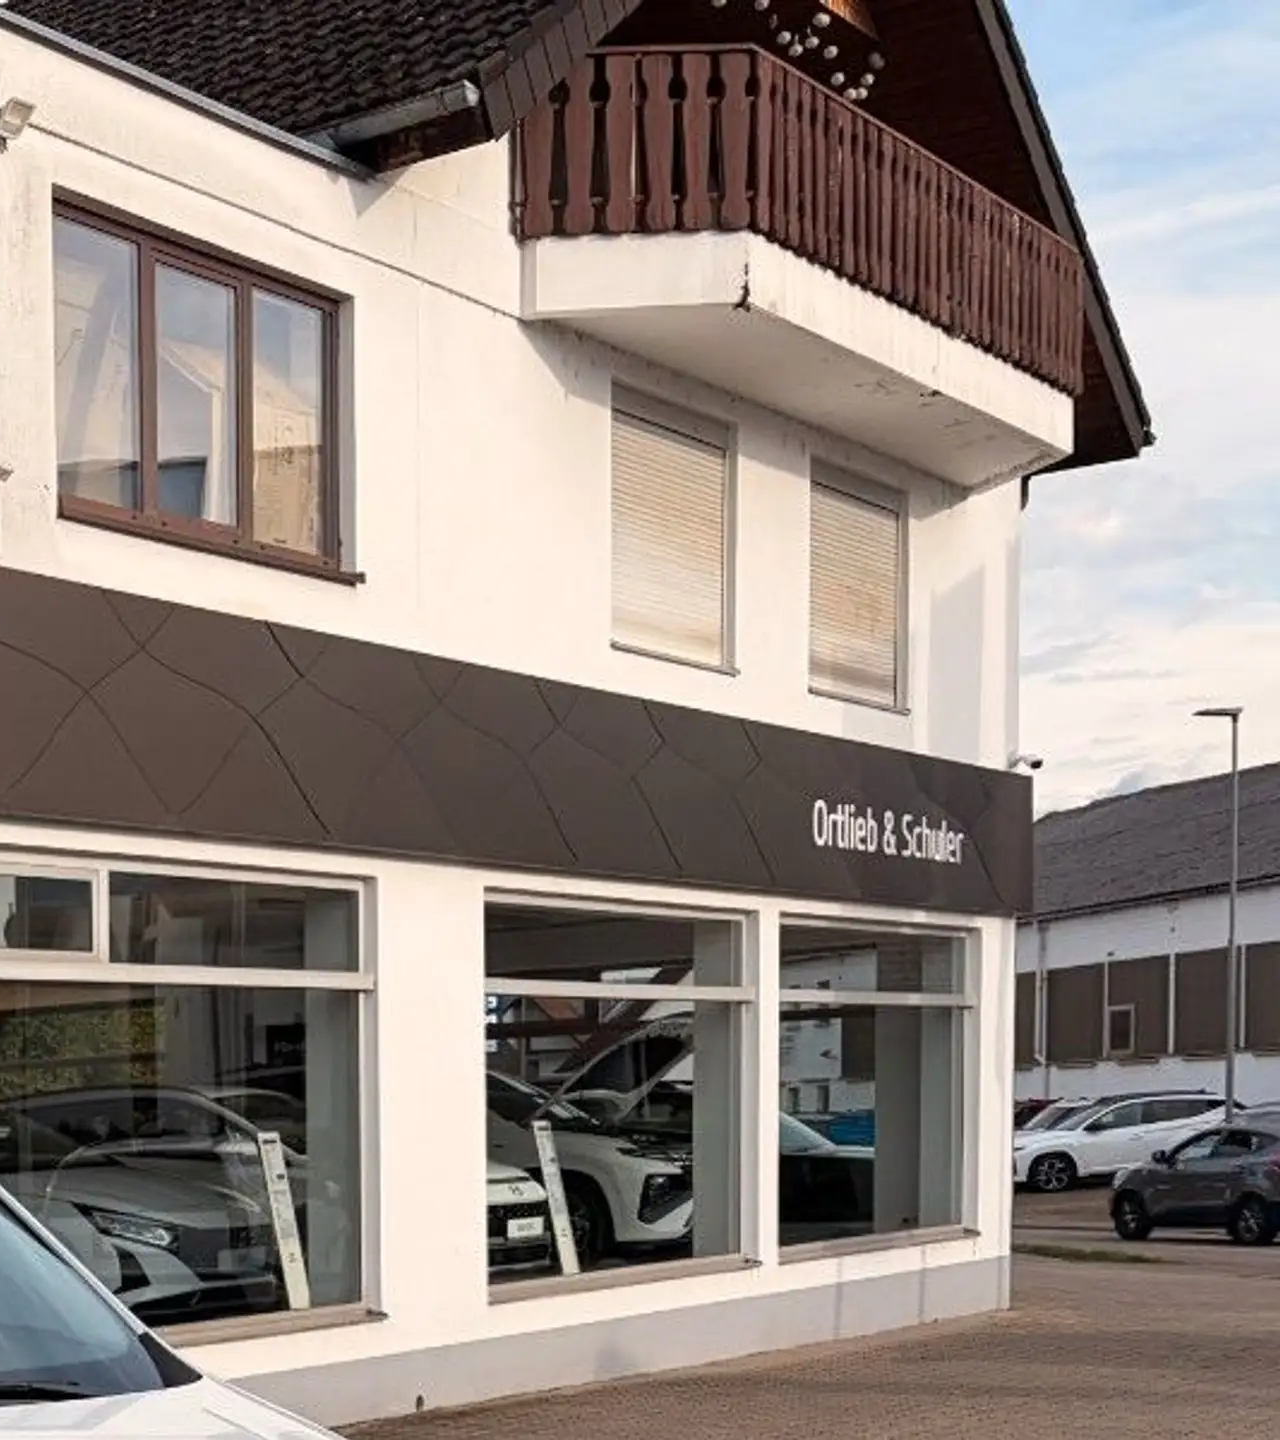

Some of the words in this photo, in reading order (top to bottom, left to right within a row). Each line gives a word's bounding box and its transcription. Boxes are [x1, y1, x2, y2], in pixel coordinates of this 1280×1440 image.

[812, 799, 879, 853] Ortlieb
[882, 809, 898, 856] &
[901, 813, 965, 865] Schuler
